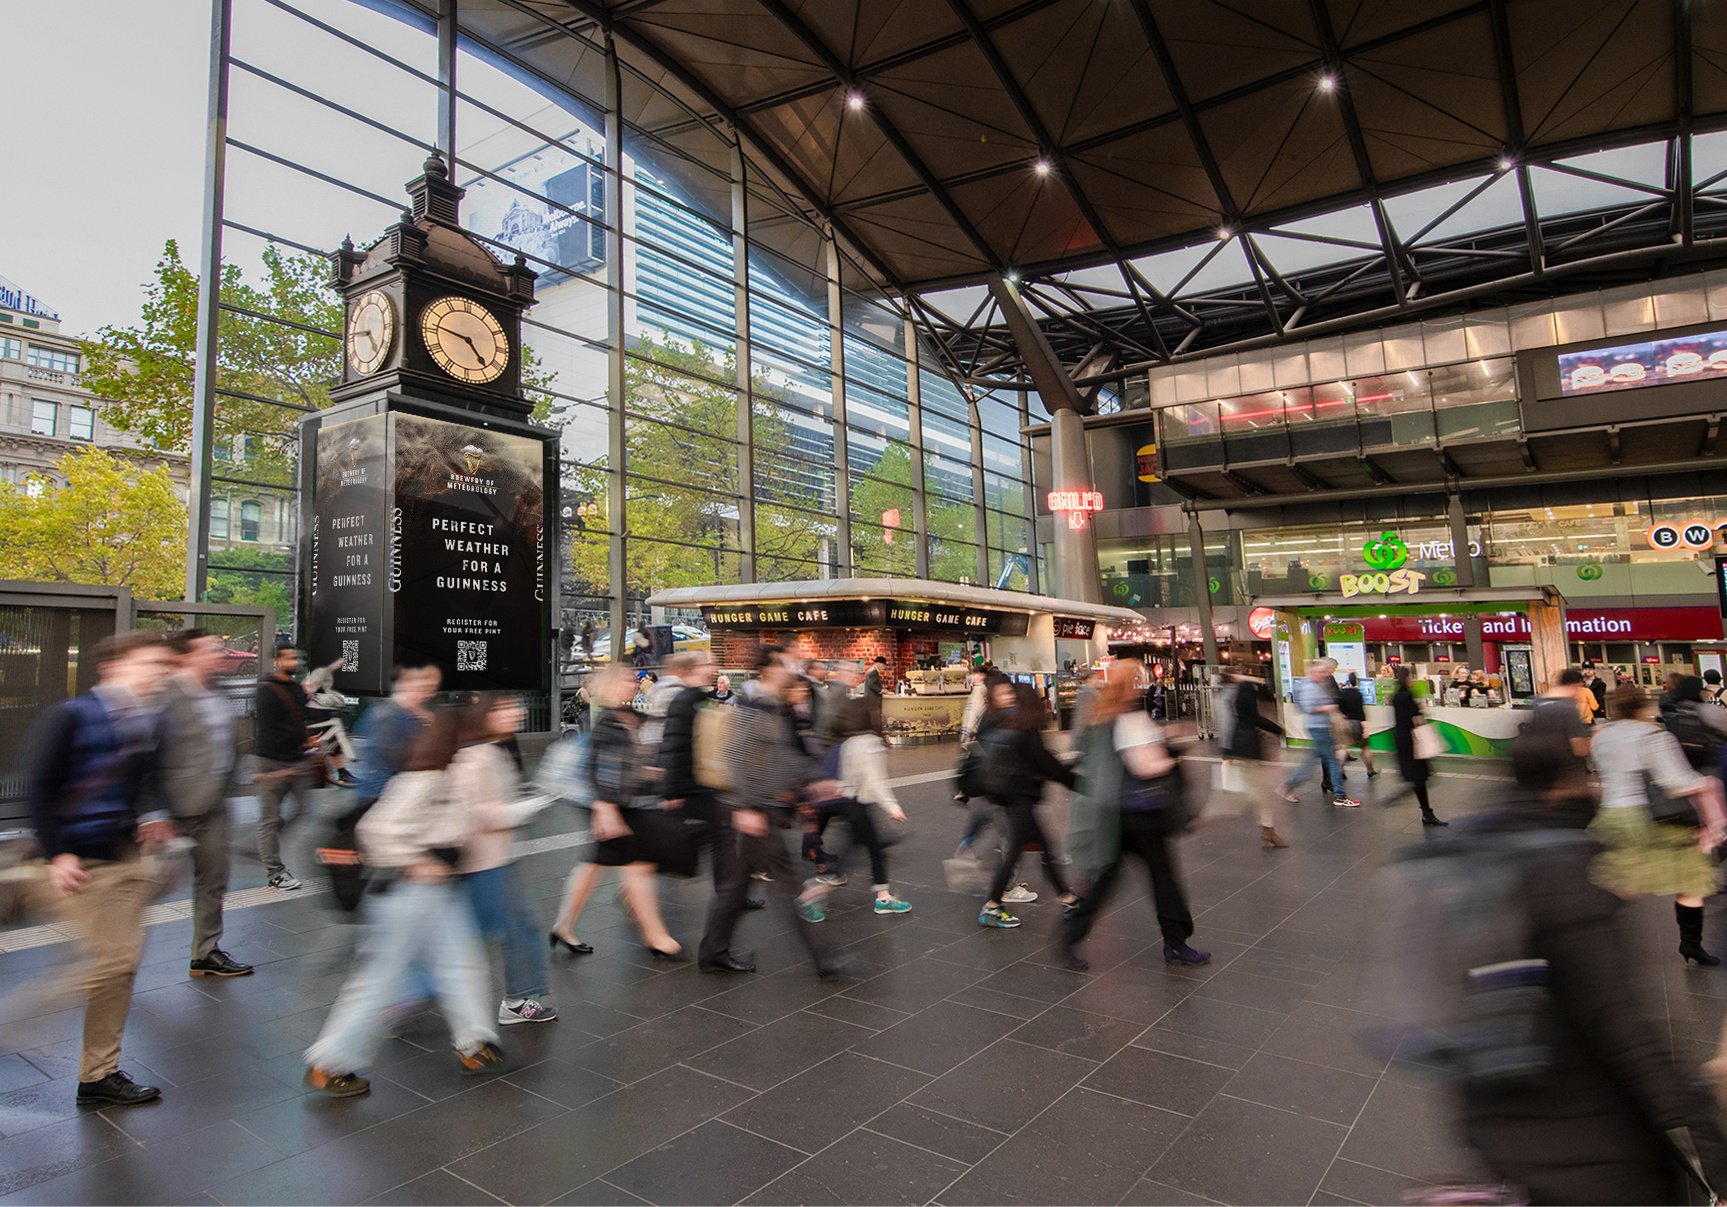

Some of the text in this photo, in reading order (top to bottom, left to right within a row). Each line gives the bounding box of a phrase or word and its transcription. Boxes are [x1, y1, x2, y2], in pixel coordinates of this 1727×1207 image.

[450, 473, 484, 485] BREWERY
[447, 482, 497, 495] METEOROLOGY
[332, 515, 365, 530] PERFECT
[432, 518, 494, 536] PERFECT
[338, 534, 374, 548] WEATHER
[388, 504, 403, 593] GUINNESS
[445, 538, 509, 557] WEATHER
[346, 553, 369, 567] FOR A
[462, 559, 502, 574] FOR A
[333, 573, 372, 587] GUINNESS
[436, 576, 507, 592] GUINNESS
[1339, 568, 1426, 599] BOOST
[446, 618, 498, 627] REGISTER FOR
[710, 610, 829, 624] HUNGER GAME CAFE
[890, 609, 987, 627] HUNGER GAME CAFE
[465, 627, 483, 635] FREE
[1483, 617, 1516, 634] and
